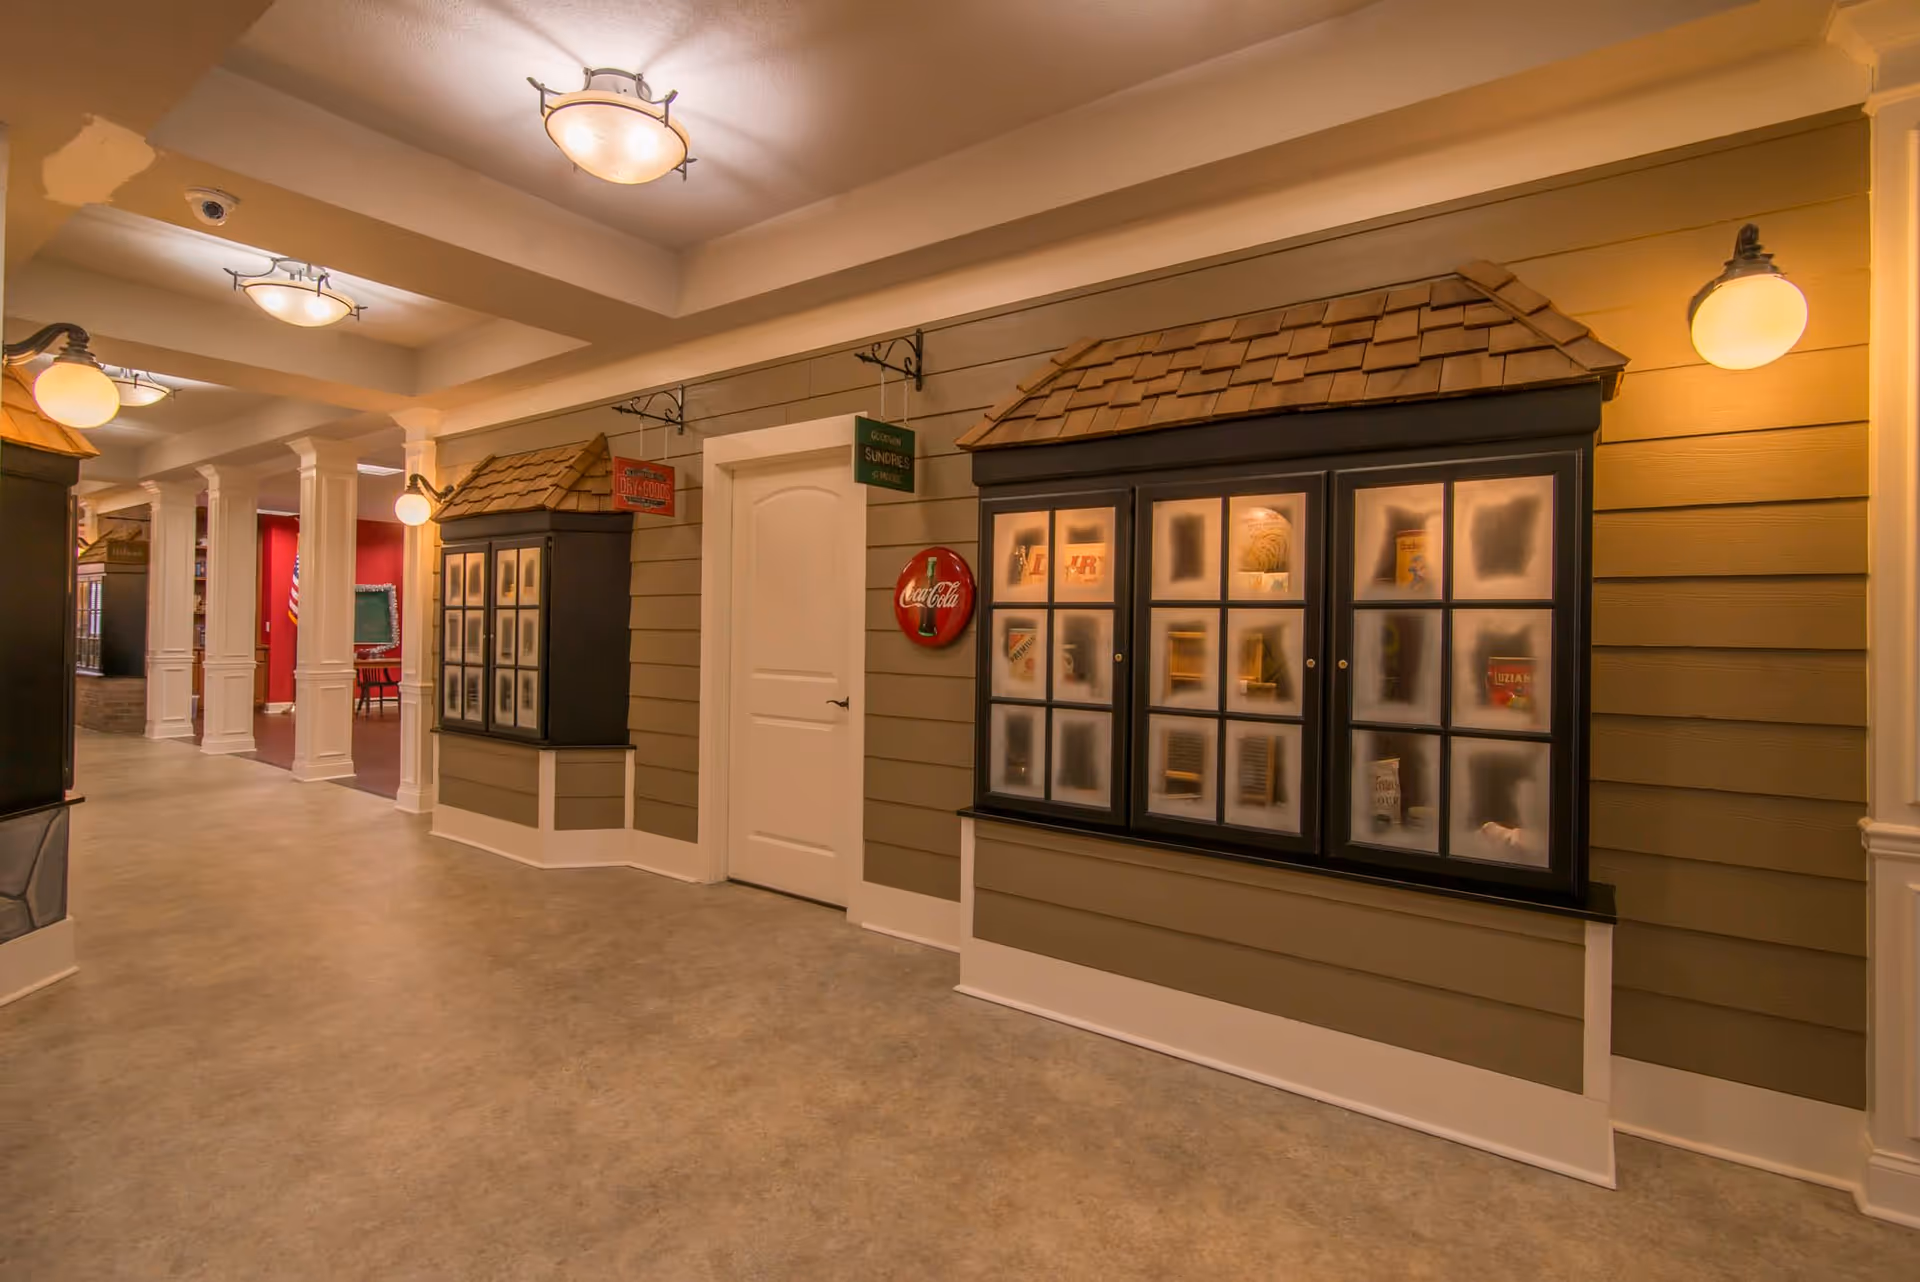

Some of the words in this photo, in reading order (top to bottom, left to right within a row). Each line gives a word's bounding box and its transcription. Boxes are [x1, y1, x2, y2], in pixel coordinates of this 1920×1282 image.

[620, 477, 638, 496] DRY
[643, 481, 671, 500] GOODS
[899, 580, 961, 608] Coca-Cola
